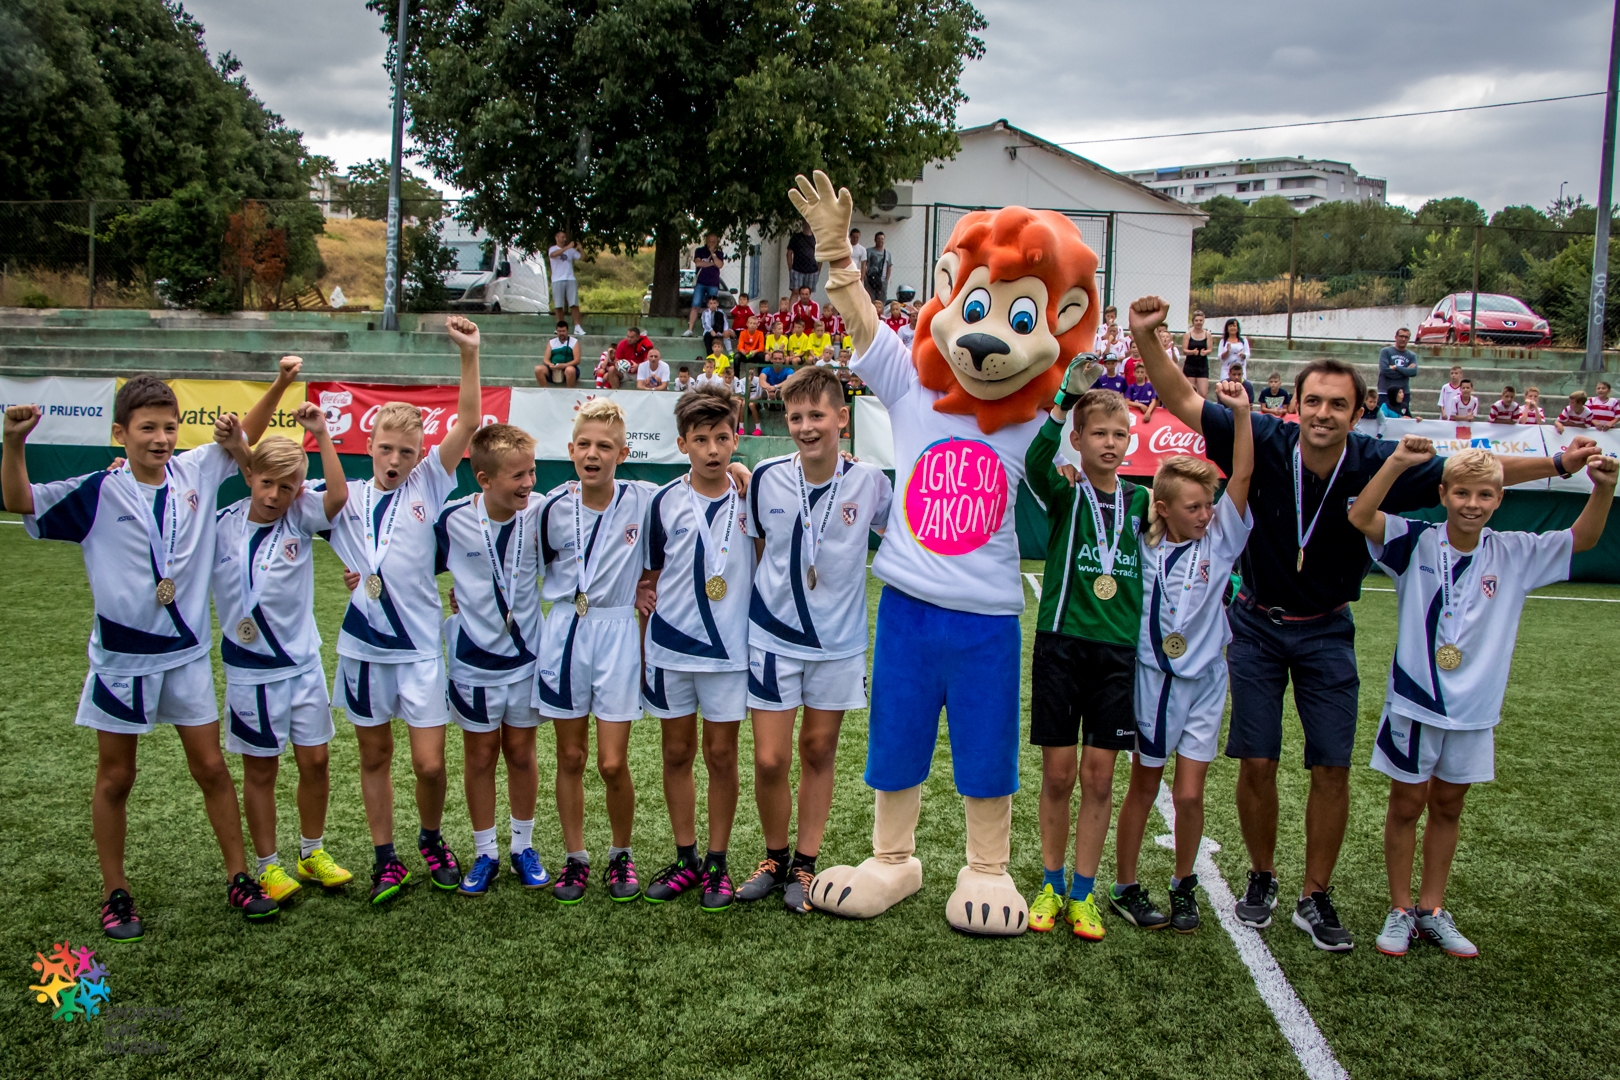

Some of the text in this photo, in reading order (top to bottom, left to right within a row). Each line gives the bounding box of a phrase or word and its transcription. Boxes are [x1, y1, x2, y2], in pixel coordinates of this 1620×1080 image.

[50, 405, 103, 417] PRIJEVOZ
[625, 432, 661, 441] ORTSKE
[919, 447, 1001, 494] IGRE SU
[916, 494, 1002, 542] ZAKON!
